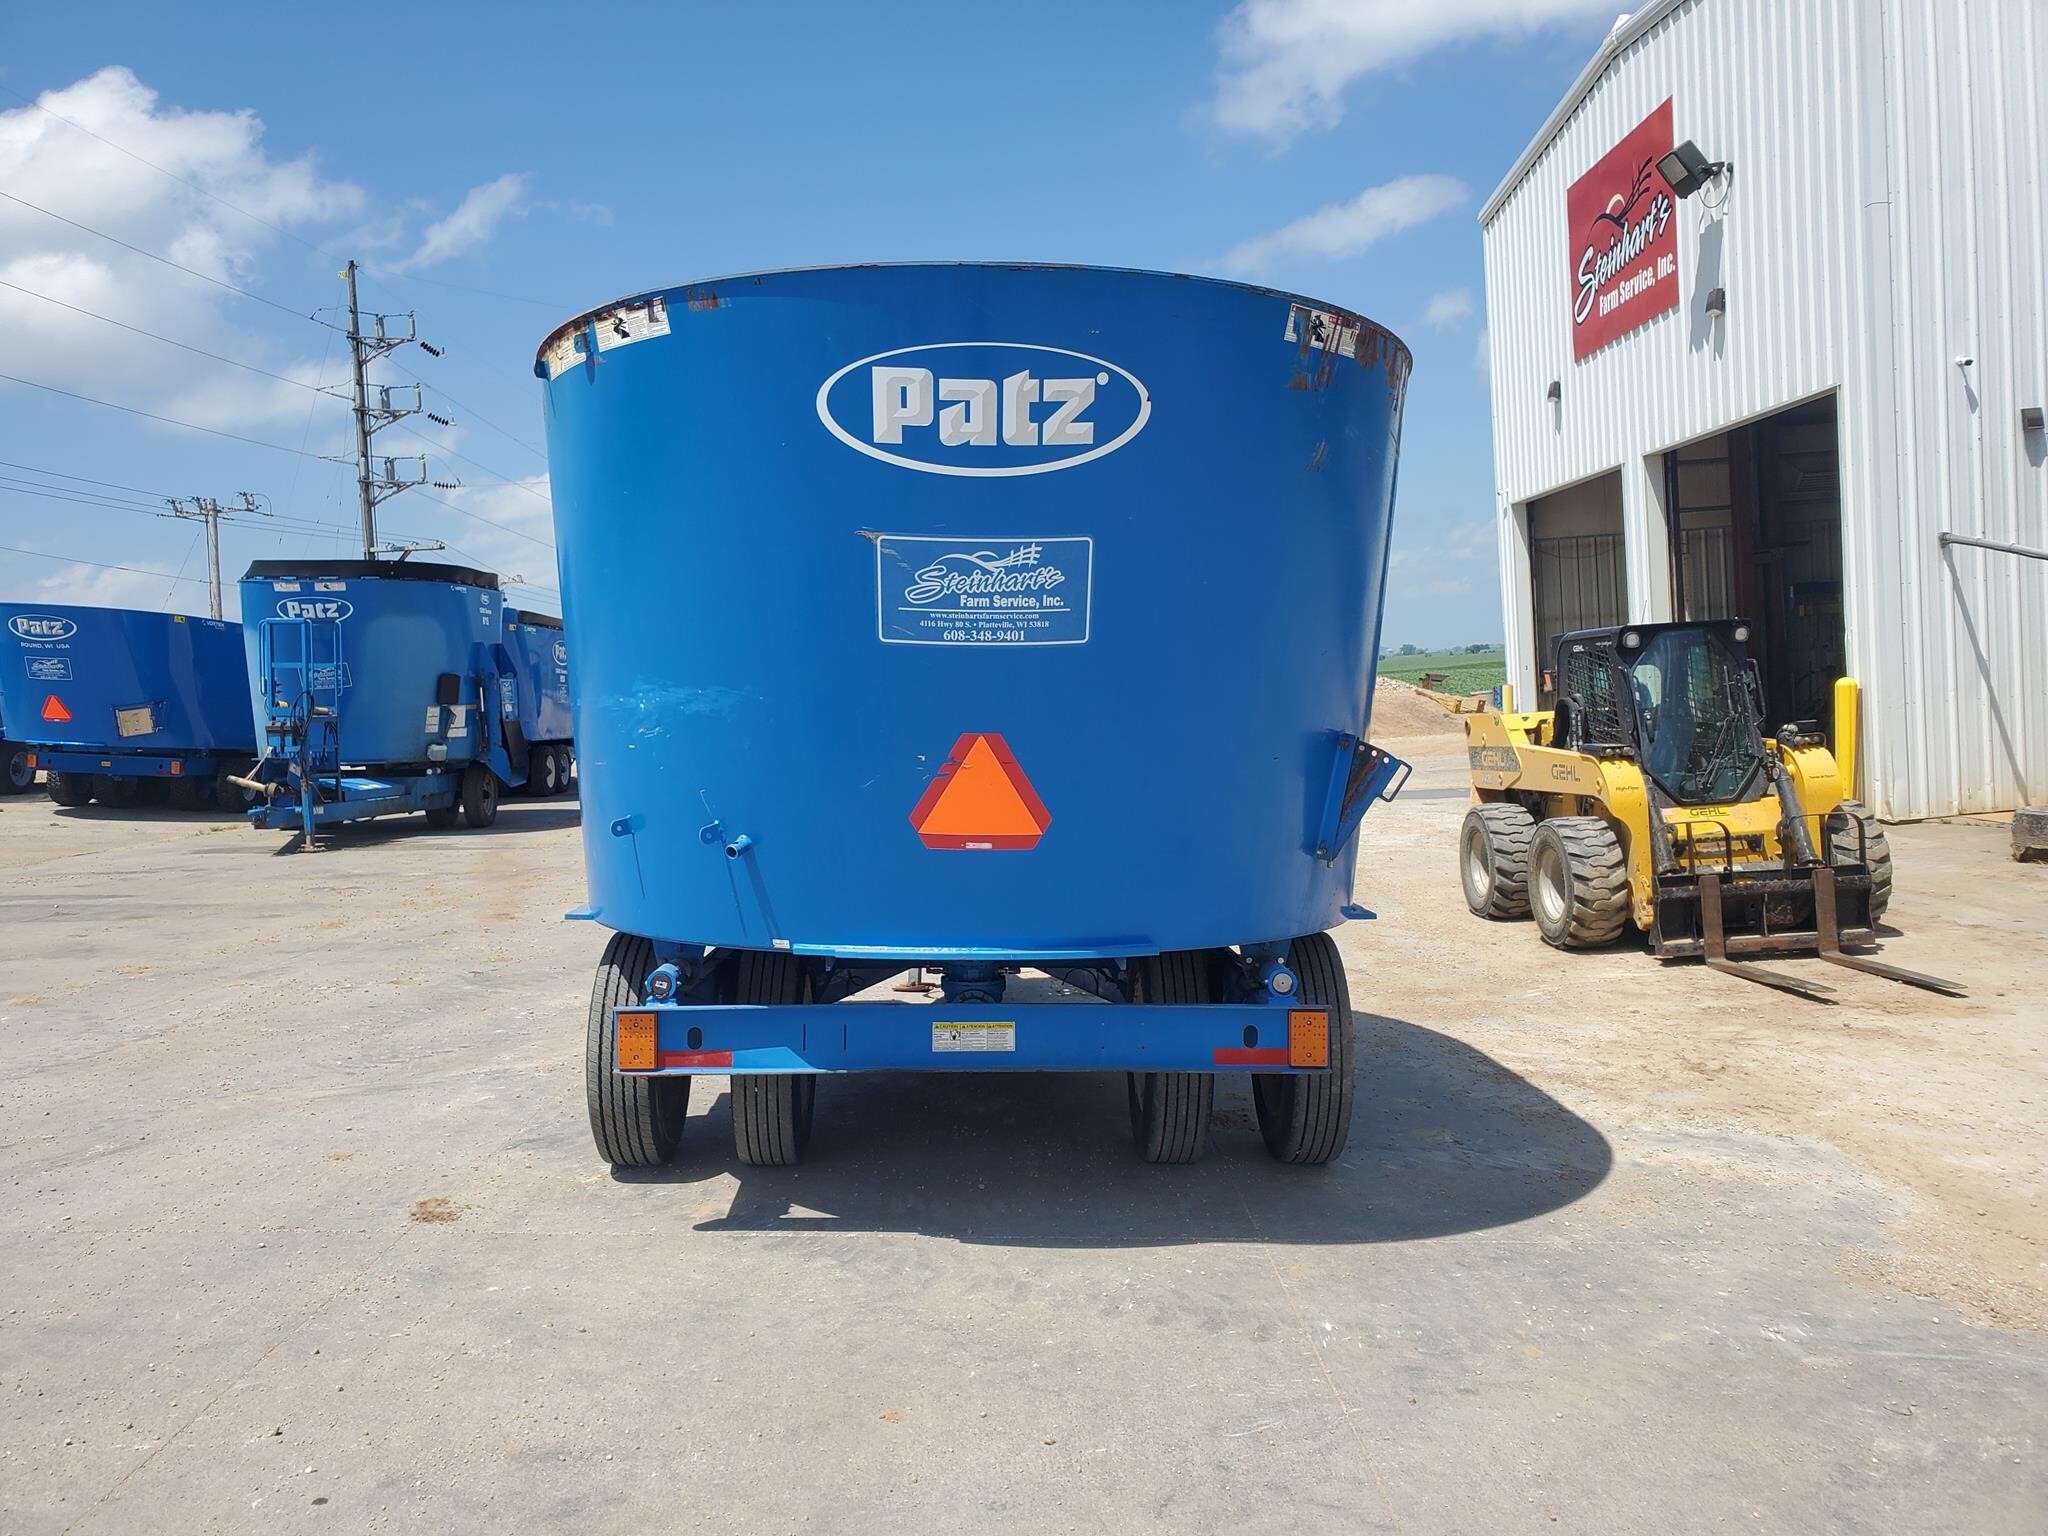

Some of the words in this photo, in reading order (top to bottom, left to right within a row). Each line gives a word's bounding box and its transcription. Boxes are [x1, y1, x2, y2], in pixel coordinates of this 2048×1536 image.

[1574, 190, 1672, 325] Steinhart's
[1599, 288, 1619, 317] Farm
[1619, 266, 1655, 304] Service,
[1657, 253, 1676, 280] Inc.
[905, 565, 1064, 604] Steinhart's
[286, 601, 340, 619] Patz
[960, 594, 990, 608] Farm
[992, 594, 1040, 609] Service,
[1042, 594, 1064, 607] Inc.
[929, 611, 1040, 620] www.steinhartsfarmservice.com
[16, 618, 65, 635] Patz
[919, 620, 936, 628] 4116
[937, 620, 954, 629] Hwy
[978, 621, 1015, 629] Platteville,
[1028, 620, 1050, 628] 53818
[943, 629, 1026, 641] 608-348-9401
[1551, 763, 1581, 783] GEHL
[1689, 807, 1727, 817] GEHL
